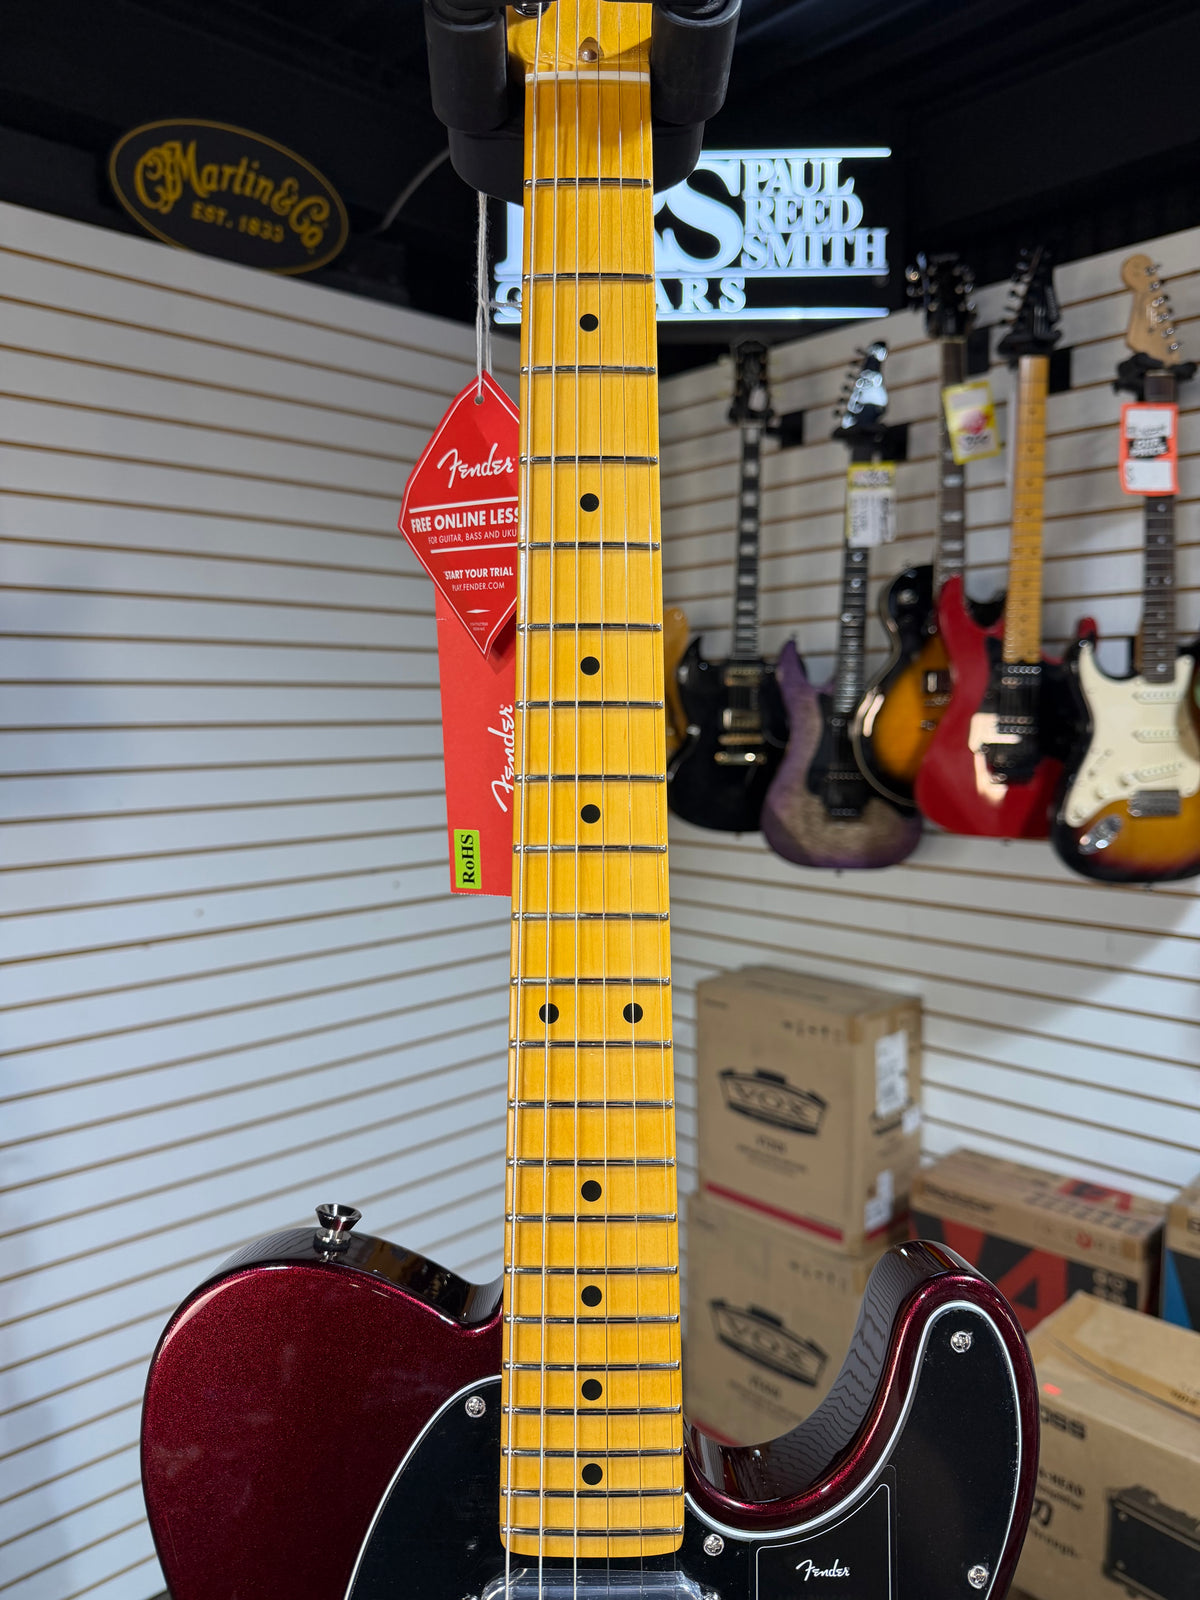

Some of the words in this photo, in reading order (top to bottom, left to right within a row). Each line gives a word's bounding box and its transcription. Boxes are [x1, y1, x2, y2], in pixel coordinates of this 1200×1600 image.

[741, 158, 855, 197] PAUL
[743, 194, 864, 233] REED
[740, 227, 890, 271] SMITH
[437, 443, 514, 489] Fender
[411, 516, 432, 534] FREE
[434, 510, 487, 531] ONLINE
[439, 533, 464, 544] GUITAR,
[465, 531, 482, 541] BASS
[484, 530, 500, 540] AND
[502, 528, 517, 538] UKU
[444, 569, 463, 580] START
[465, 567, 489, 579] YOUR
[490, 566, 514, 578] TRIAL
[488, 704, 515, 813] Fender
[461, 833, 476, 885] RoHS
[731, 1078, 811, 1119] VOX
[795, 1559, 849, 1582] Fender
